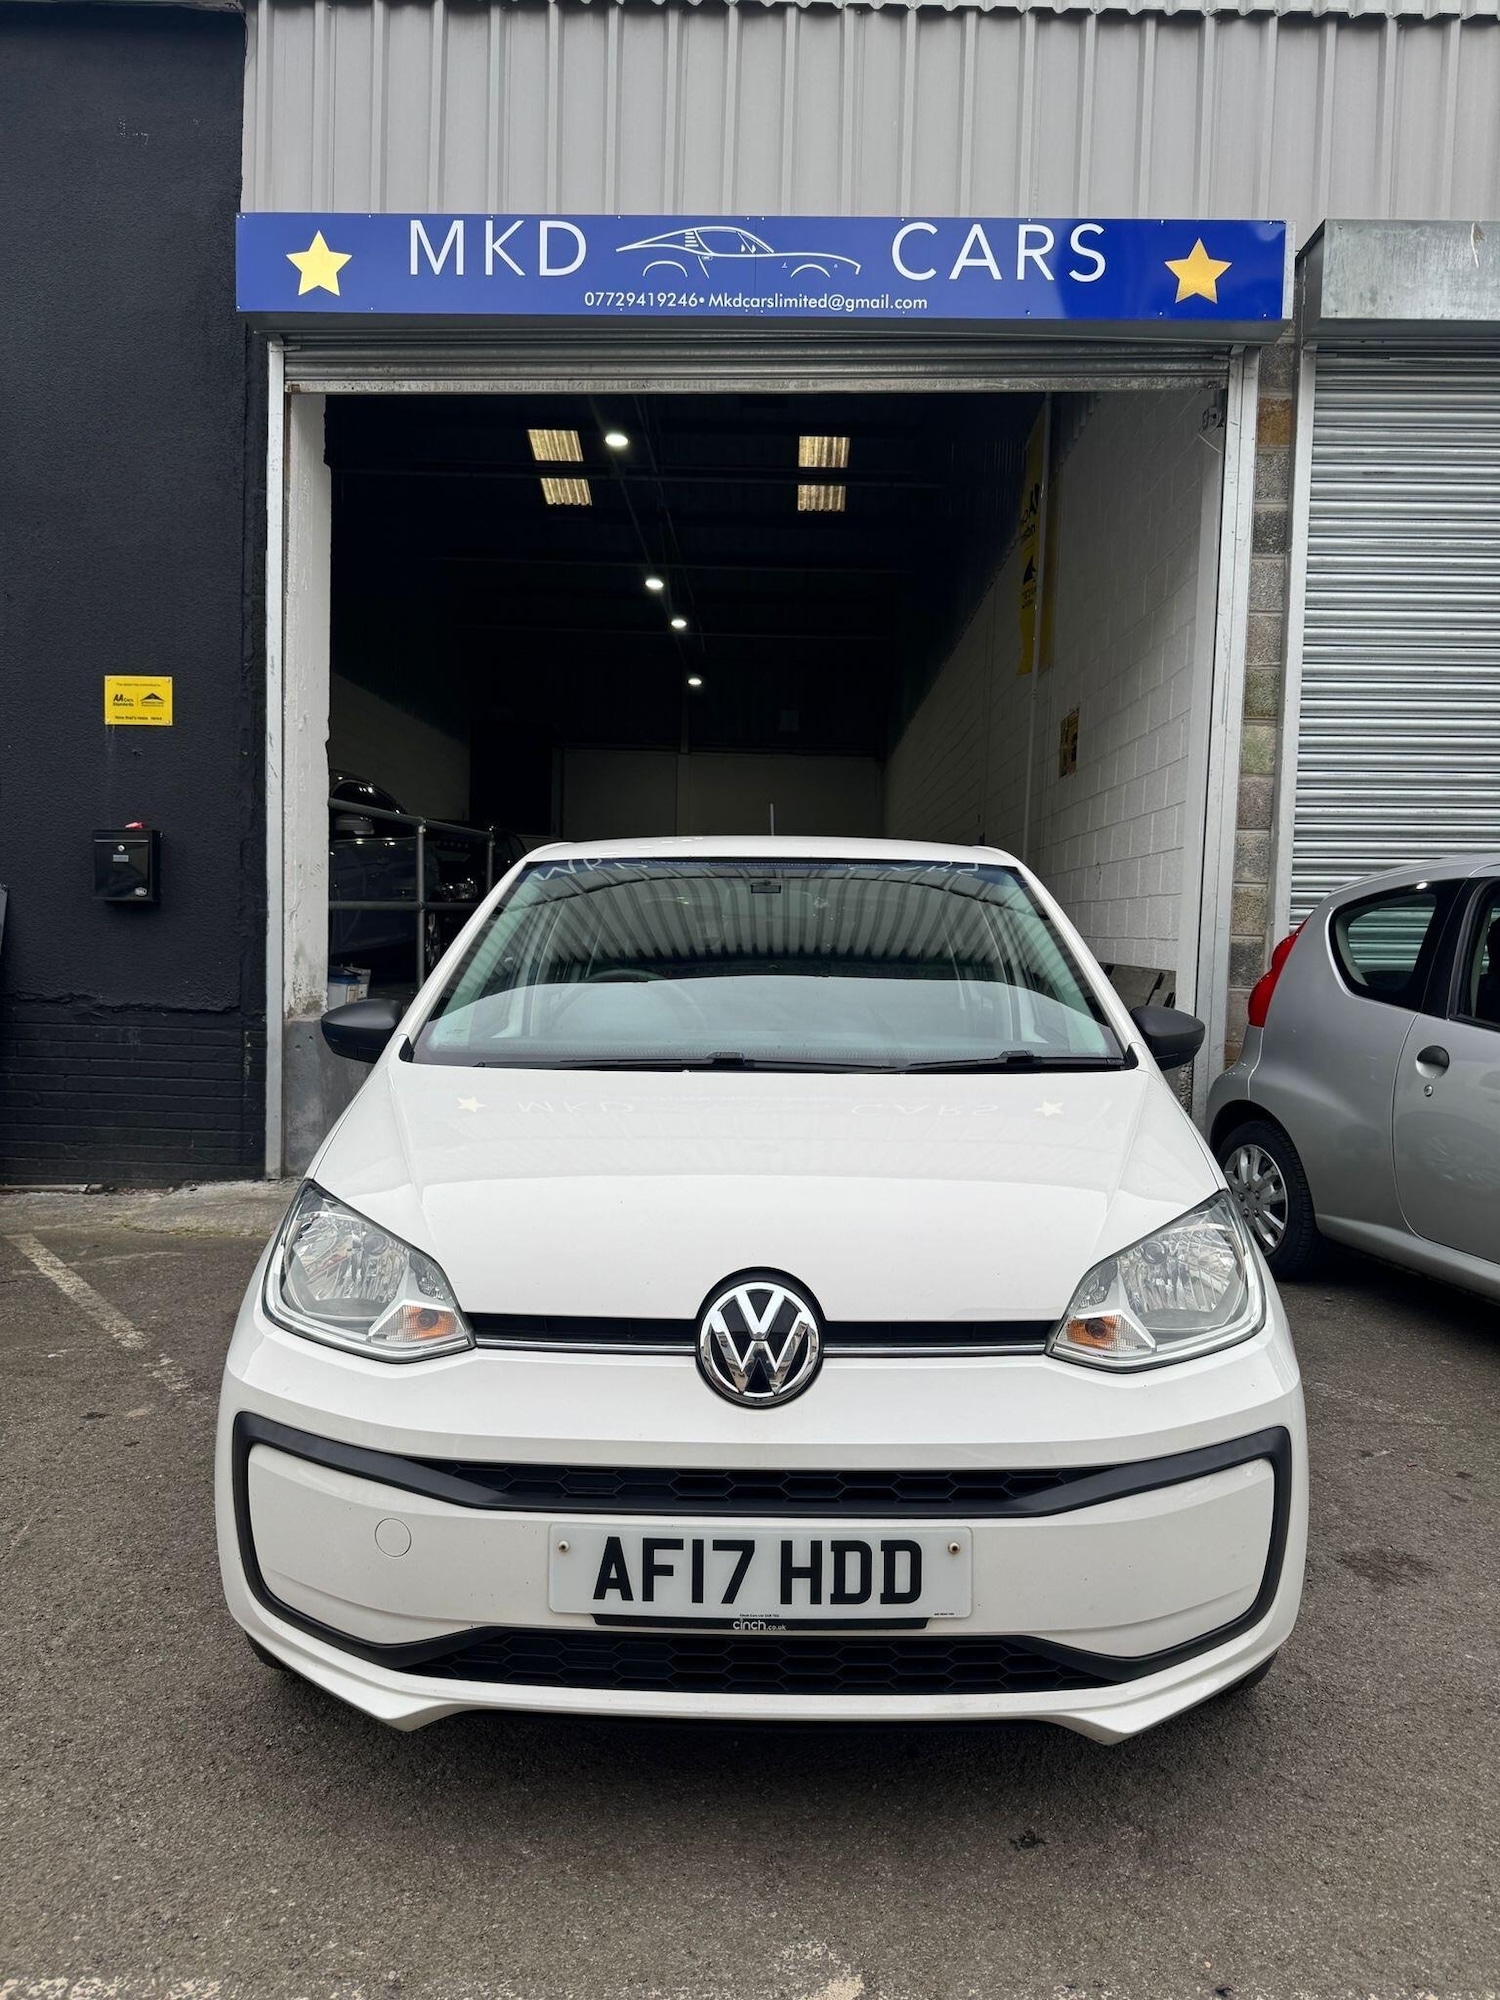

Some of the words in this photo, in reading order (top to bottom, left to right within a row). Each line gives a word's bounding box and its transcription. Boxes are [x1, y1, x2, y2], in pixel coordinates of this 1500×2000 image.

[410, 219, 587, 277] MKD
[891, 222, 1107, 283] CARS
[708, 292, 928, 311] Mkdcarslimited@gmail.com
[592, 1536, 756, 1604] AF17
[779, 1539, 923, 1605] HDD
